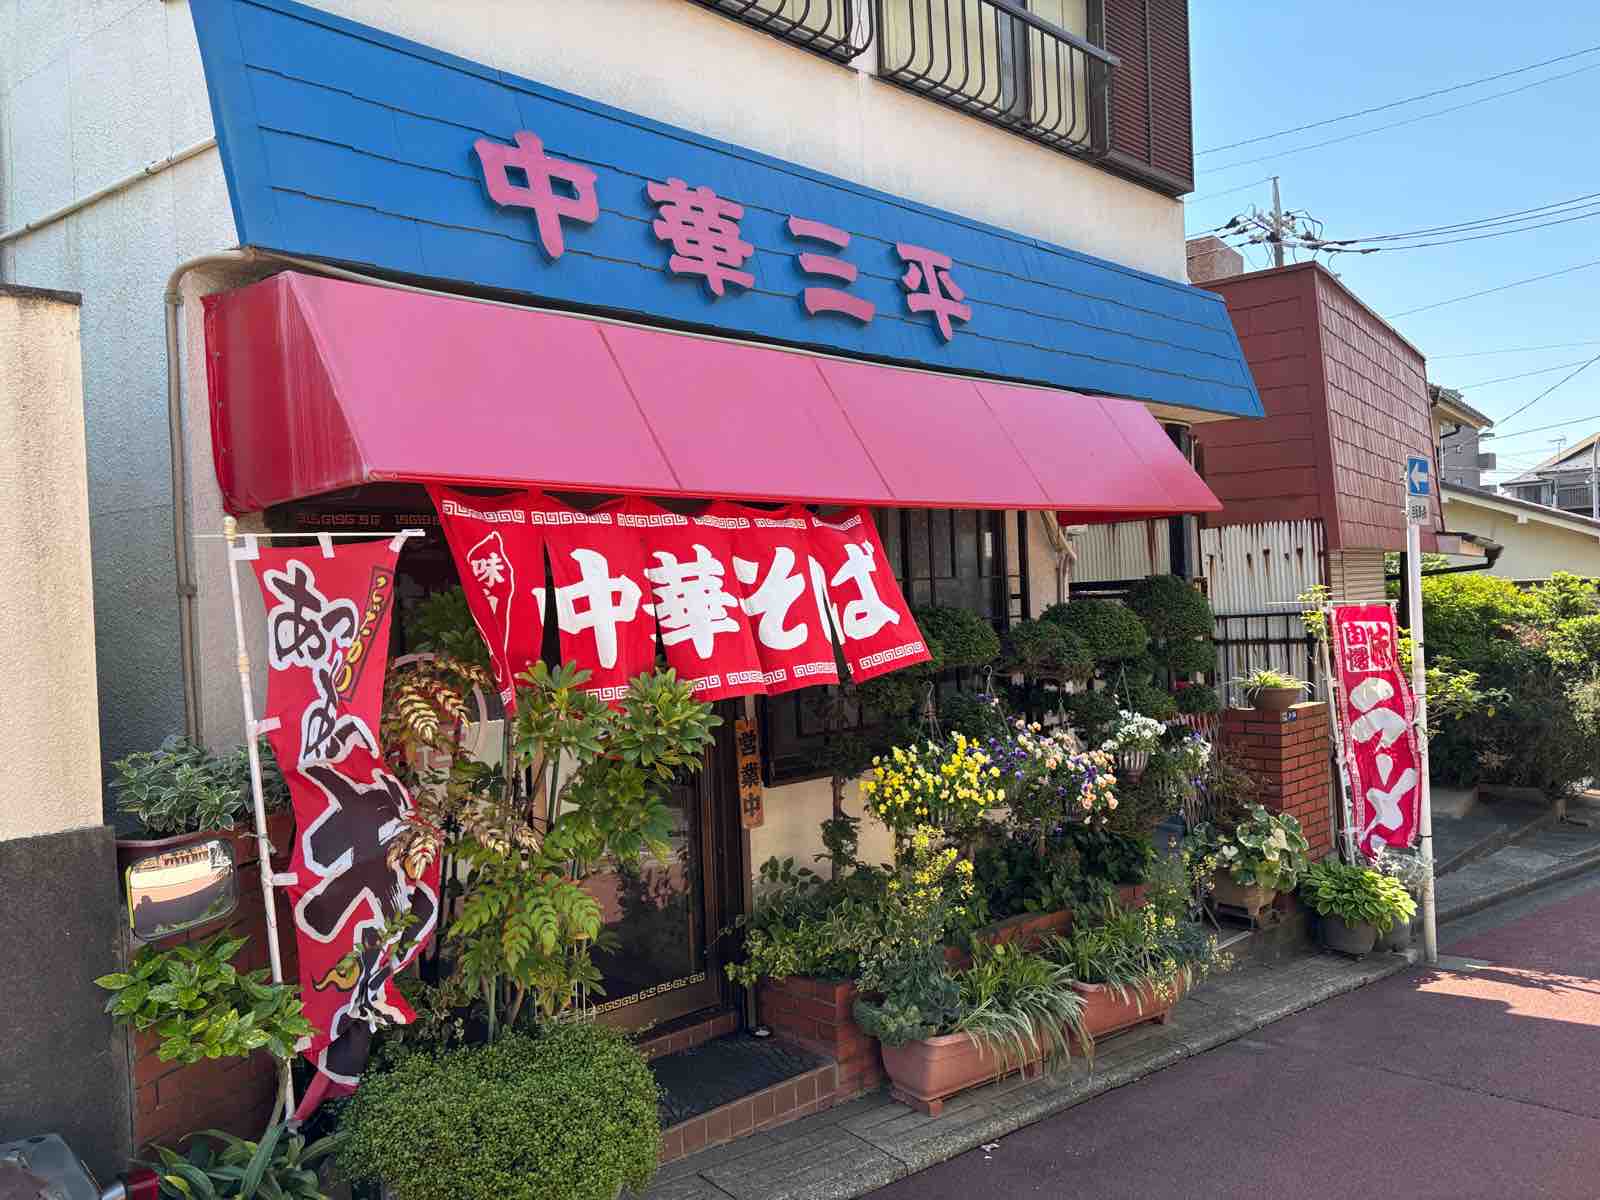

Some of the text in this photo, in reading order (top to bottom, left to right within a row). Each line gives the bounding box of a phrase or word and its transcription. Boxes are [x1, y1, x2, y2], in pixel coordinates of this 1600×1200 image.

[473, 130, 972, 344] 中華三平
[532, 541, 900, 669] 中華そば
[739, 730, 762, 817] 営業中
